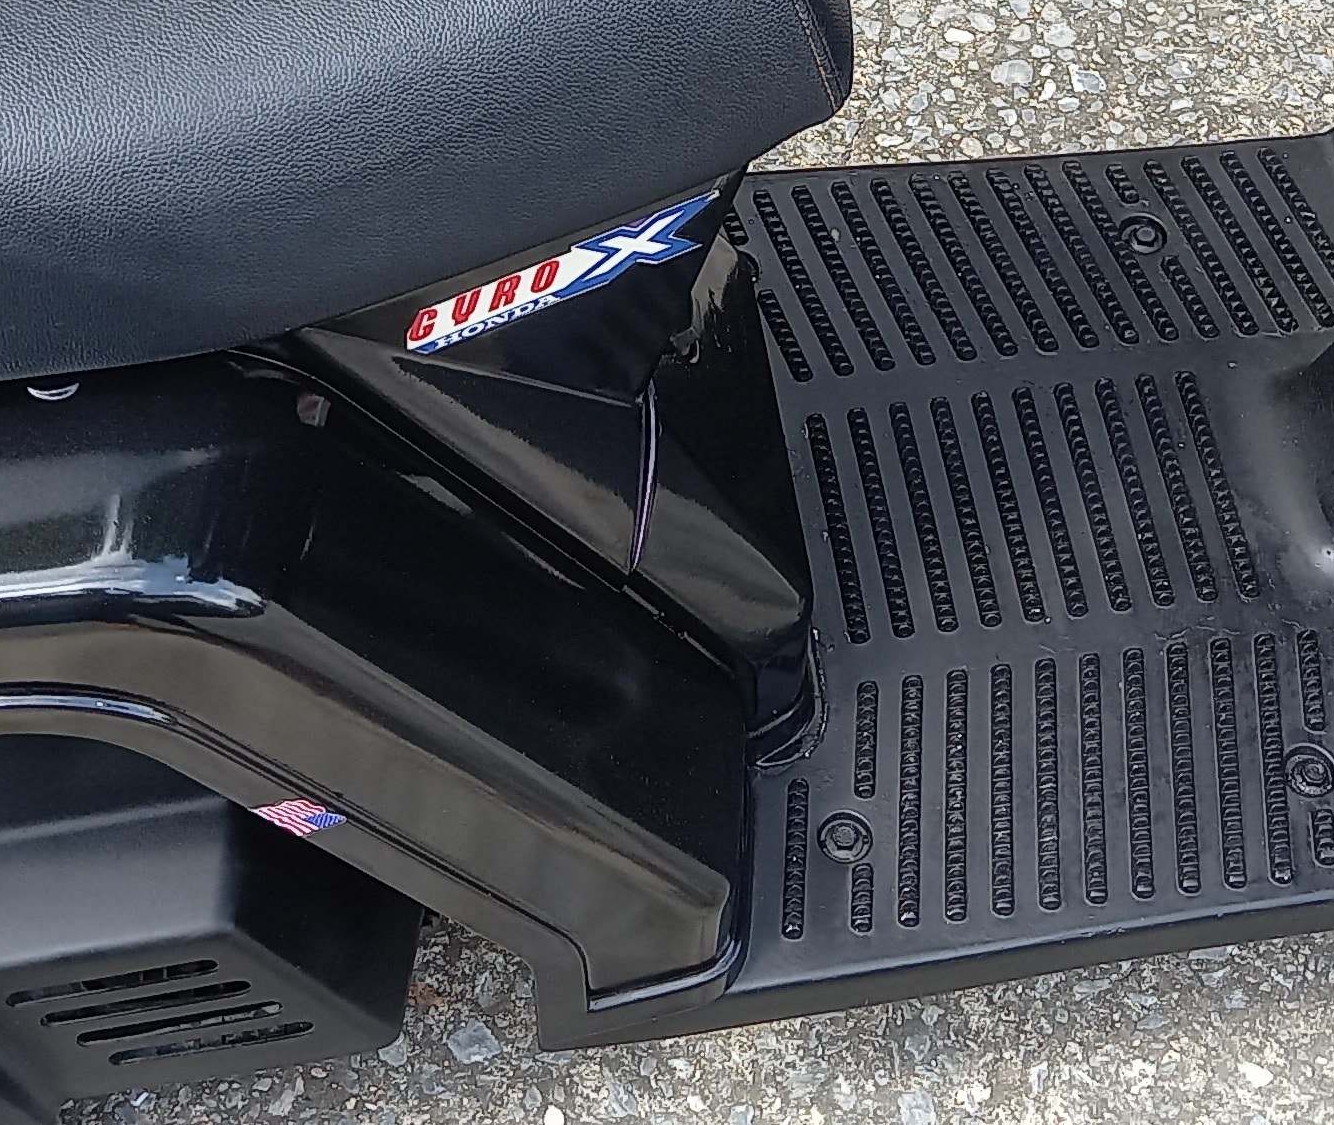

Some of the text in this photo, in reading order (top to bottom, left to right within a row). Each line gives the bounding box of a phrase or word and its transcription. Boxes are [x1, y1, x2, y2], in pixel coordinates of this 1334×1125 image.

[409, 203, 699, 342] GYRO X
[434, 294, 563, 350] HONDA
